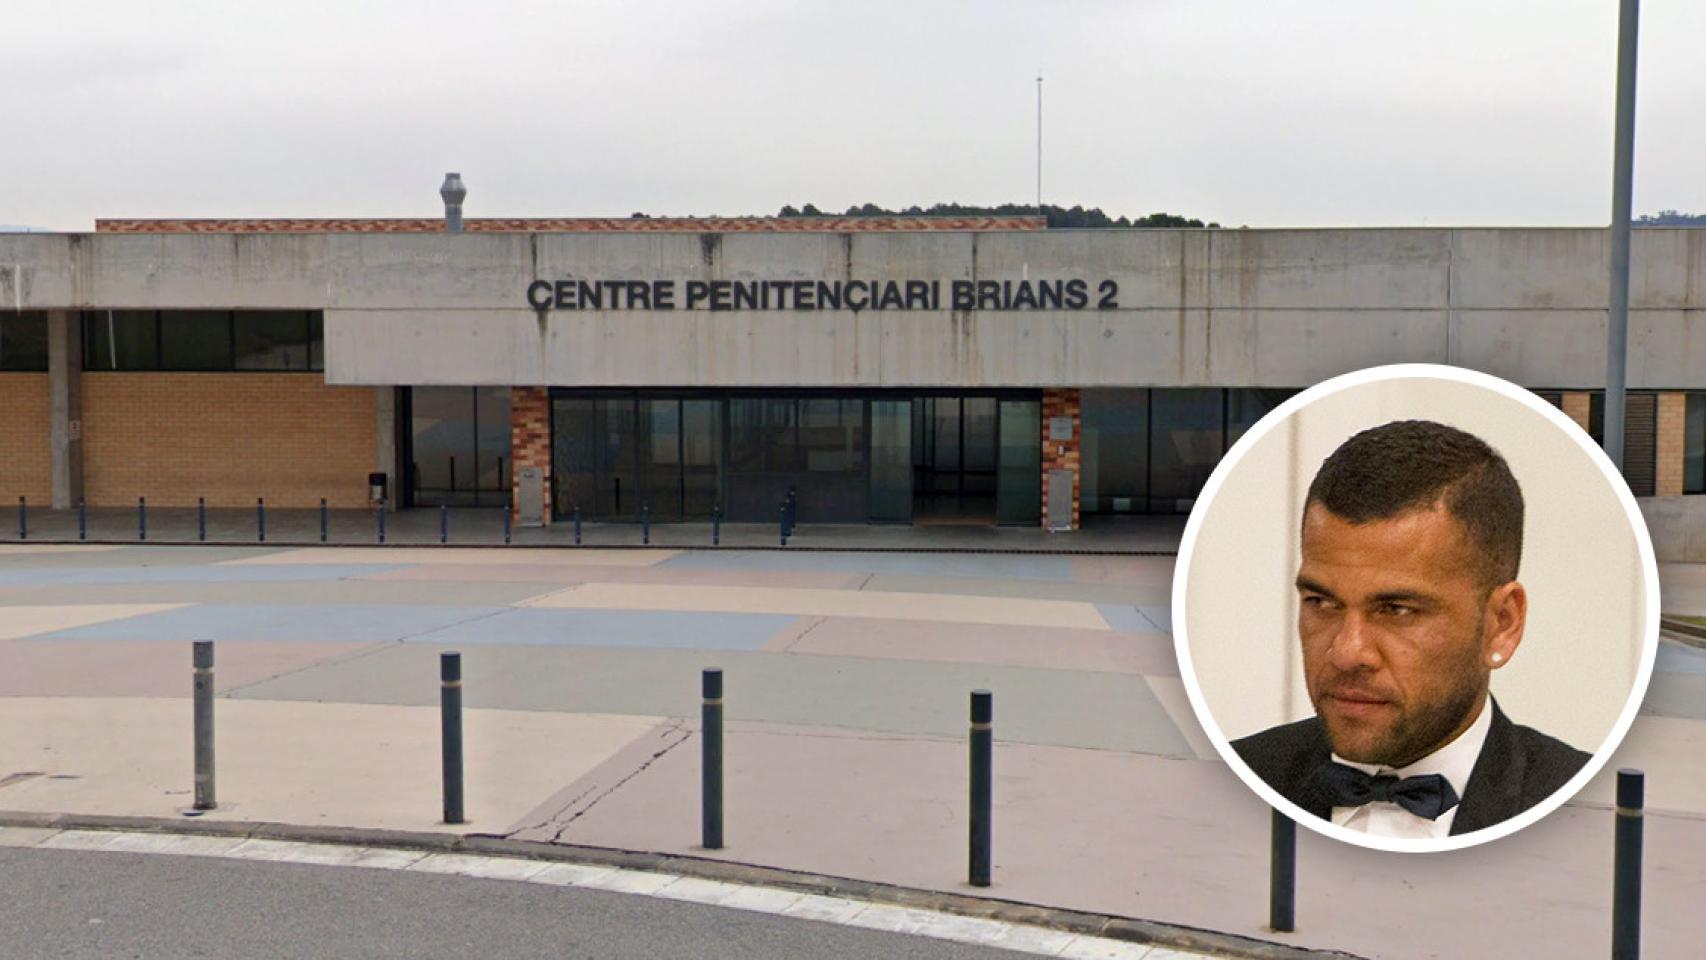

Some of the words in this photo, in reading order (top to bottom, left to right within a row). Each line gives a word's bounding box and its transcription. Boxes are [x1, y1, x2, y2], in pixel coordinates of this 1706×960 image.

[527, 280, 675, 310] CENTRE
[686, 280, 940, 311] PENITENCIARI
[952, 279, 1088, 310] BRIANS
[1098, 280, 1118, 309] 2
